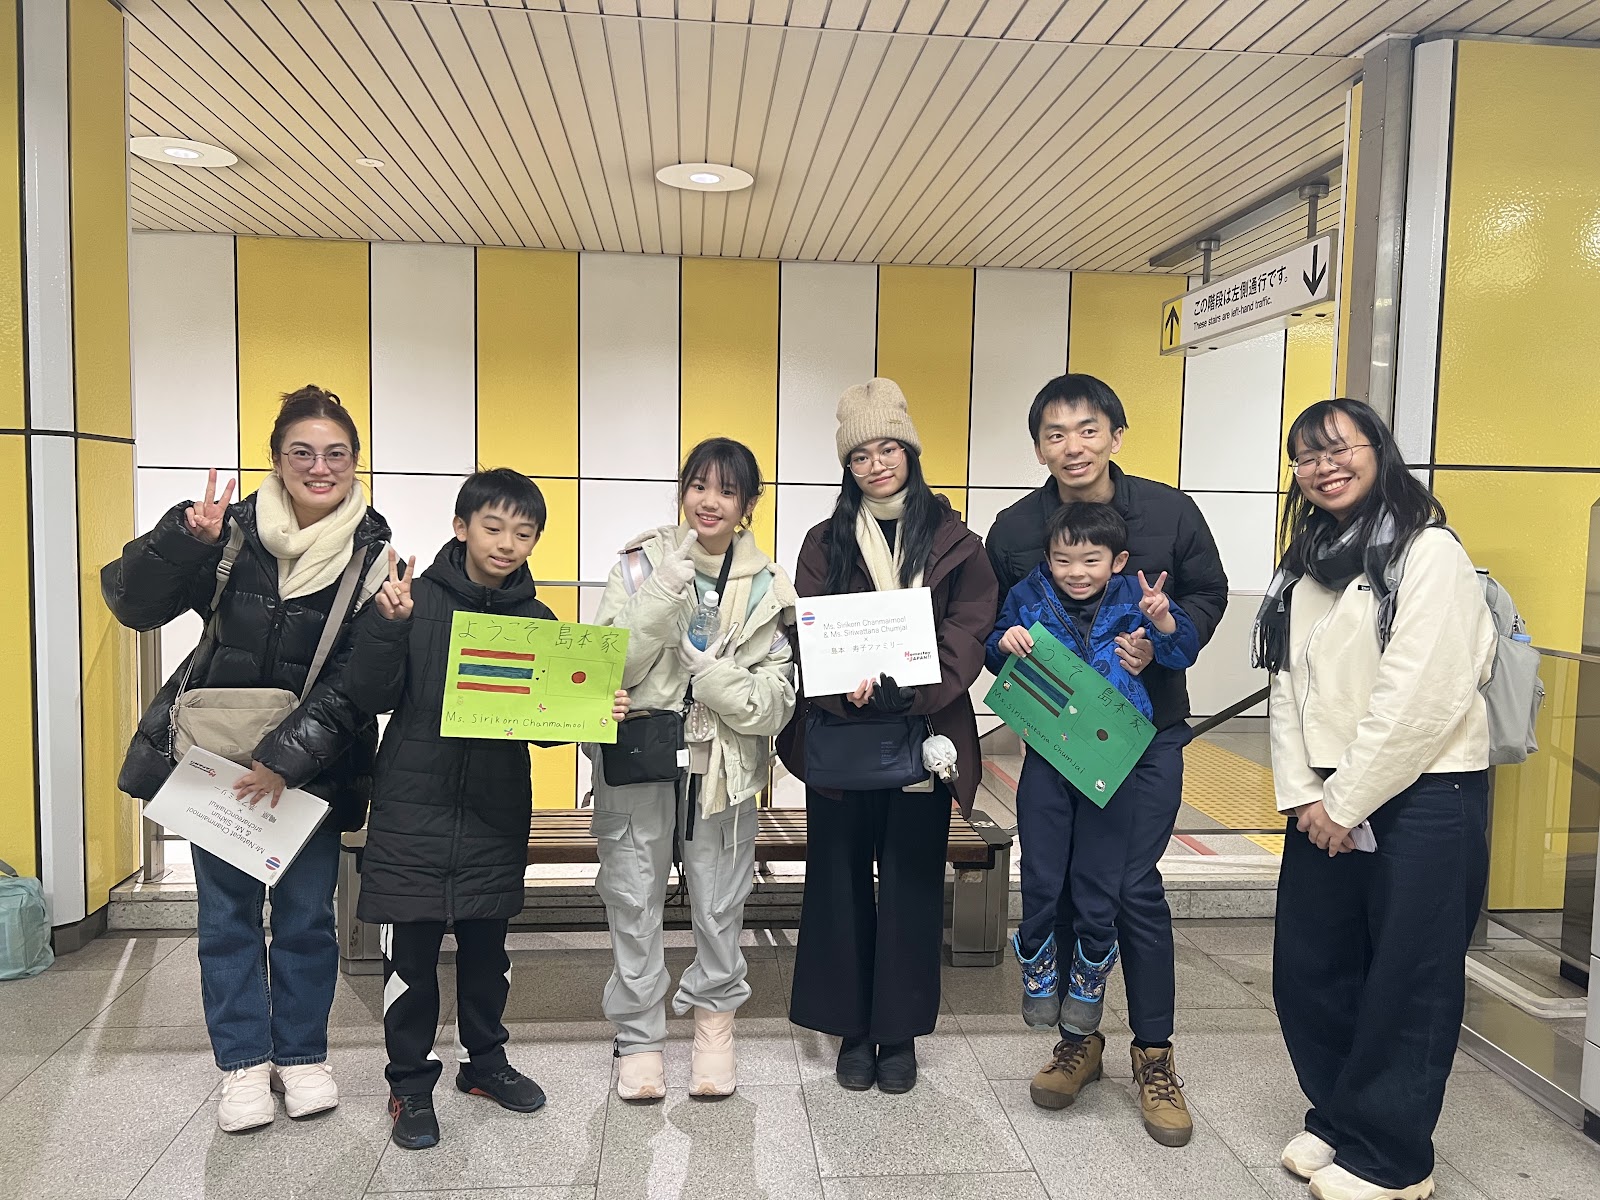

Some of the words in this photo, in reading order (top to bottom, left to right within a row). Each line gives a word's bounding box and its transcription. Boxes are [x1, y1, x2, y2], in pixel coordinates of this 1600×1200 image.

[1194, 266, 1288, 316] この階段は左側通行です。
[1193, 319, 1207, 331] These
[1208, 314, 1221, 326] stairs
[1222, 312, 1230, 321] are
[1231, 301, 1254, 318] left-hand
[1255, 296, 1272, 310] traffic.
[458, 620, 539, 644] ようこそ
[555, 624, 622, 653] 島本家
[993, 688, 1006, 705] Ms.
[445, 711, 465, 724] Ms.
[472, 713, 519, 725] Sirikorn
[211, 810, 233, 826] Sikhun
[234, 822, 245, 834] Mr.
